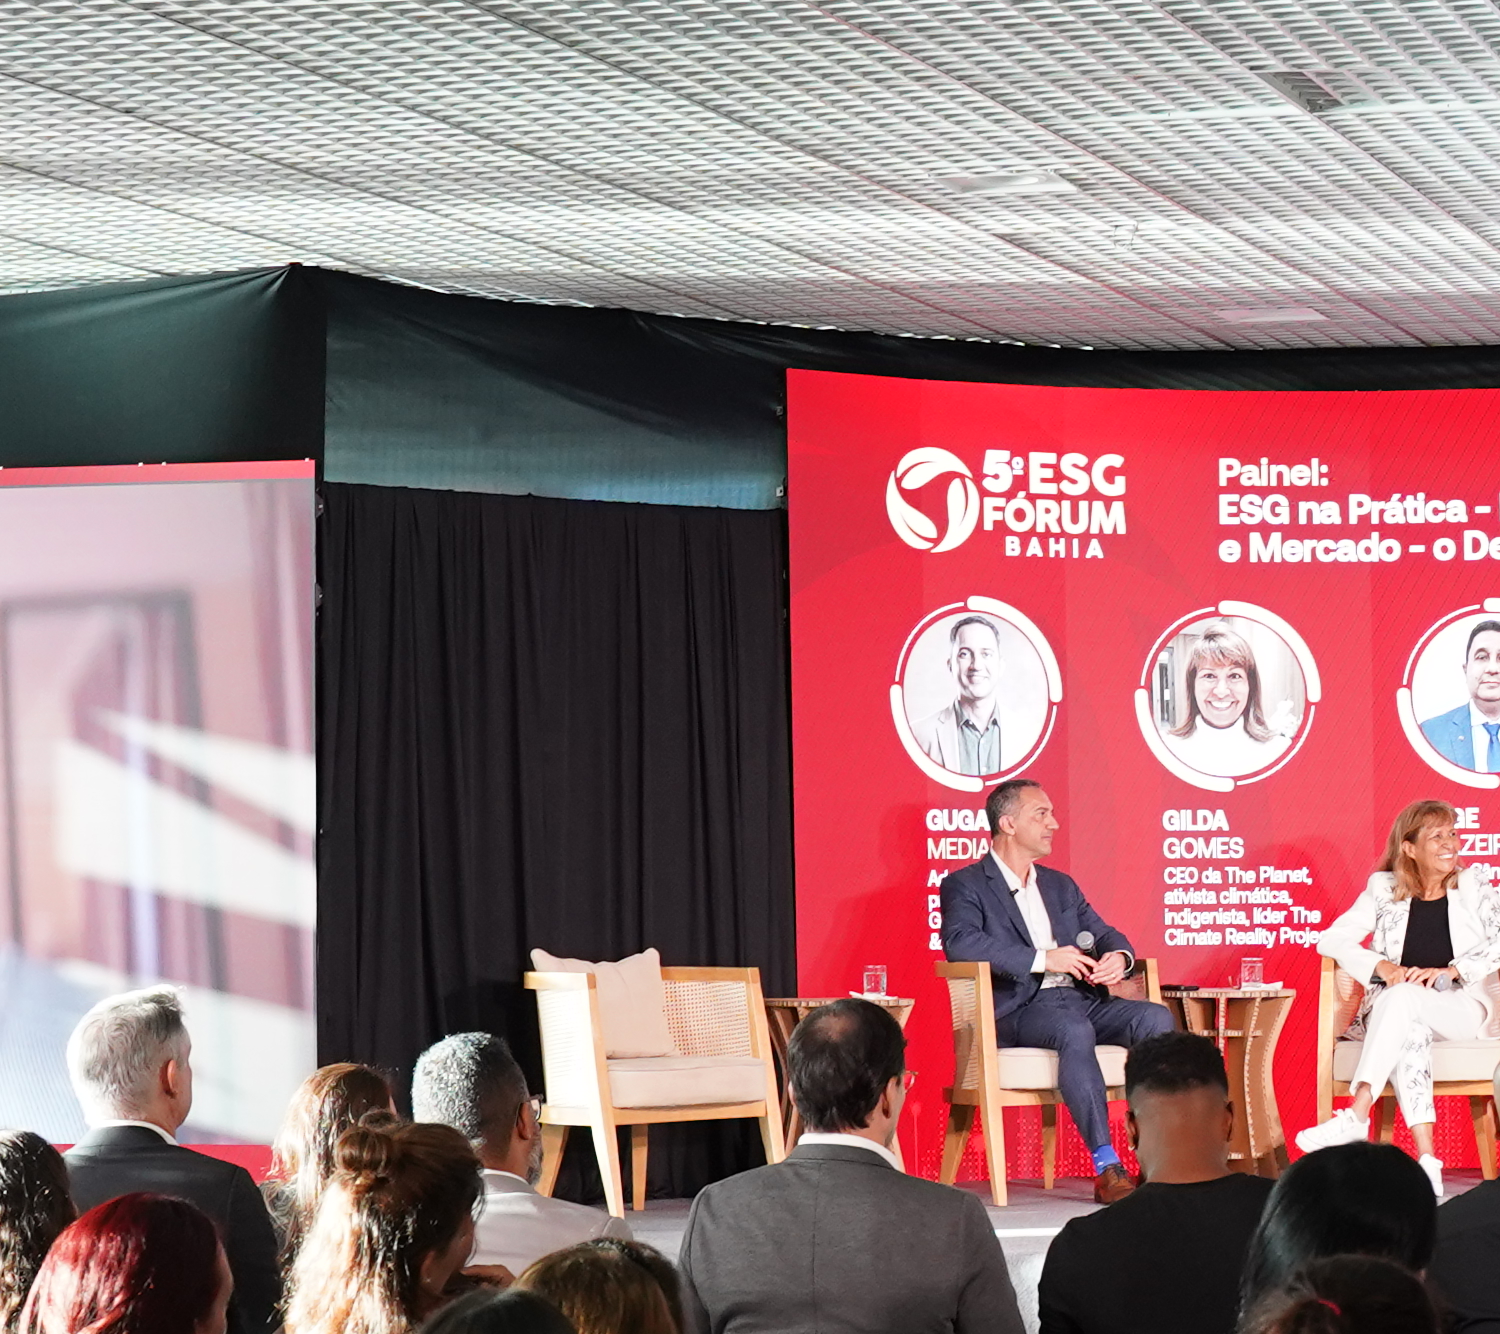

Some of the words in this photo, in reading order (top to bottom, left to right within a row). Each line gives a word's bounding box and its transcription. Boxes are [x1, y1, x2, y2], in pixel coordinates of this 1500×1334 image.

[1028, 451, 1127, 496] ESG
[1218, 457, 1329, 487] Painel:
[983, 491, 1127, 535] FÓRUM
[1218, 494, 1290, 525] ESG
[1298, 500, 1342, 525] na
[1349, 492, 1469, 525] Prática
[1004, 535, 1105, 559] BAHIA
[1218, 539, 1242, 563] e
[1249, 531, 1402, 563] Mercado
[1432, 537, 1457, 561] o
[925, 808, 991, 832] GUGA
[1162, 809, 1230, 832] GILDA
[1162, 836, 1245, 859] GOMES
[1163, 866, 1199, 885] CEO
[1201, 866, 1223, 884] da
[1224, 866, 1257, 884] The
[1259, 865, 1313, 886] Planet,
[1163, 887, 1217, 905] ativista
[1219, 886, 1294, 906] climática,
[1164, 907, 1251, 929] indigenista,
[1252, 907, 1288, 925] líder
[1289, 906, 1322, 924] The
[1164, 928, 1223, 946] Climate
[1225, 927, 1277, 949] Reality
[1279, 926, 1325, 948] Proje
